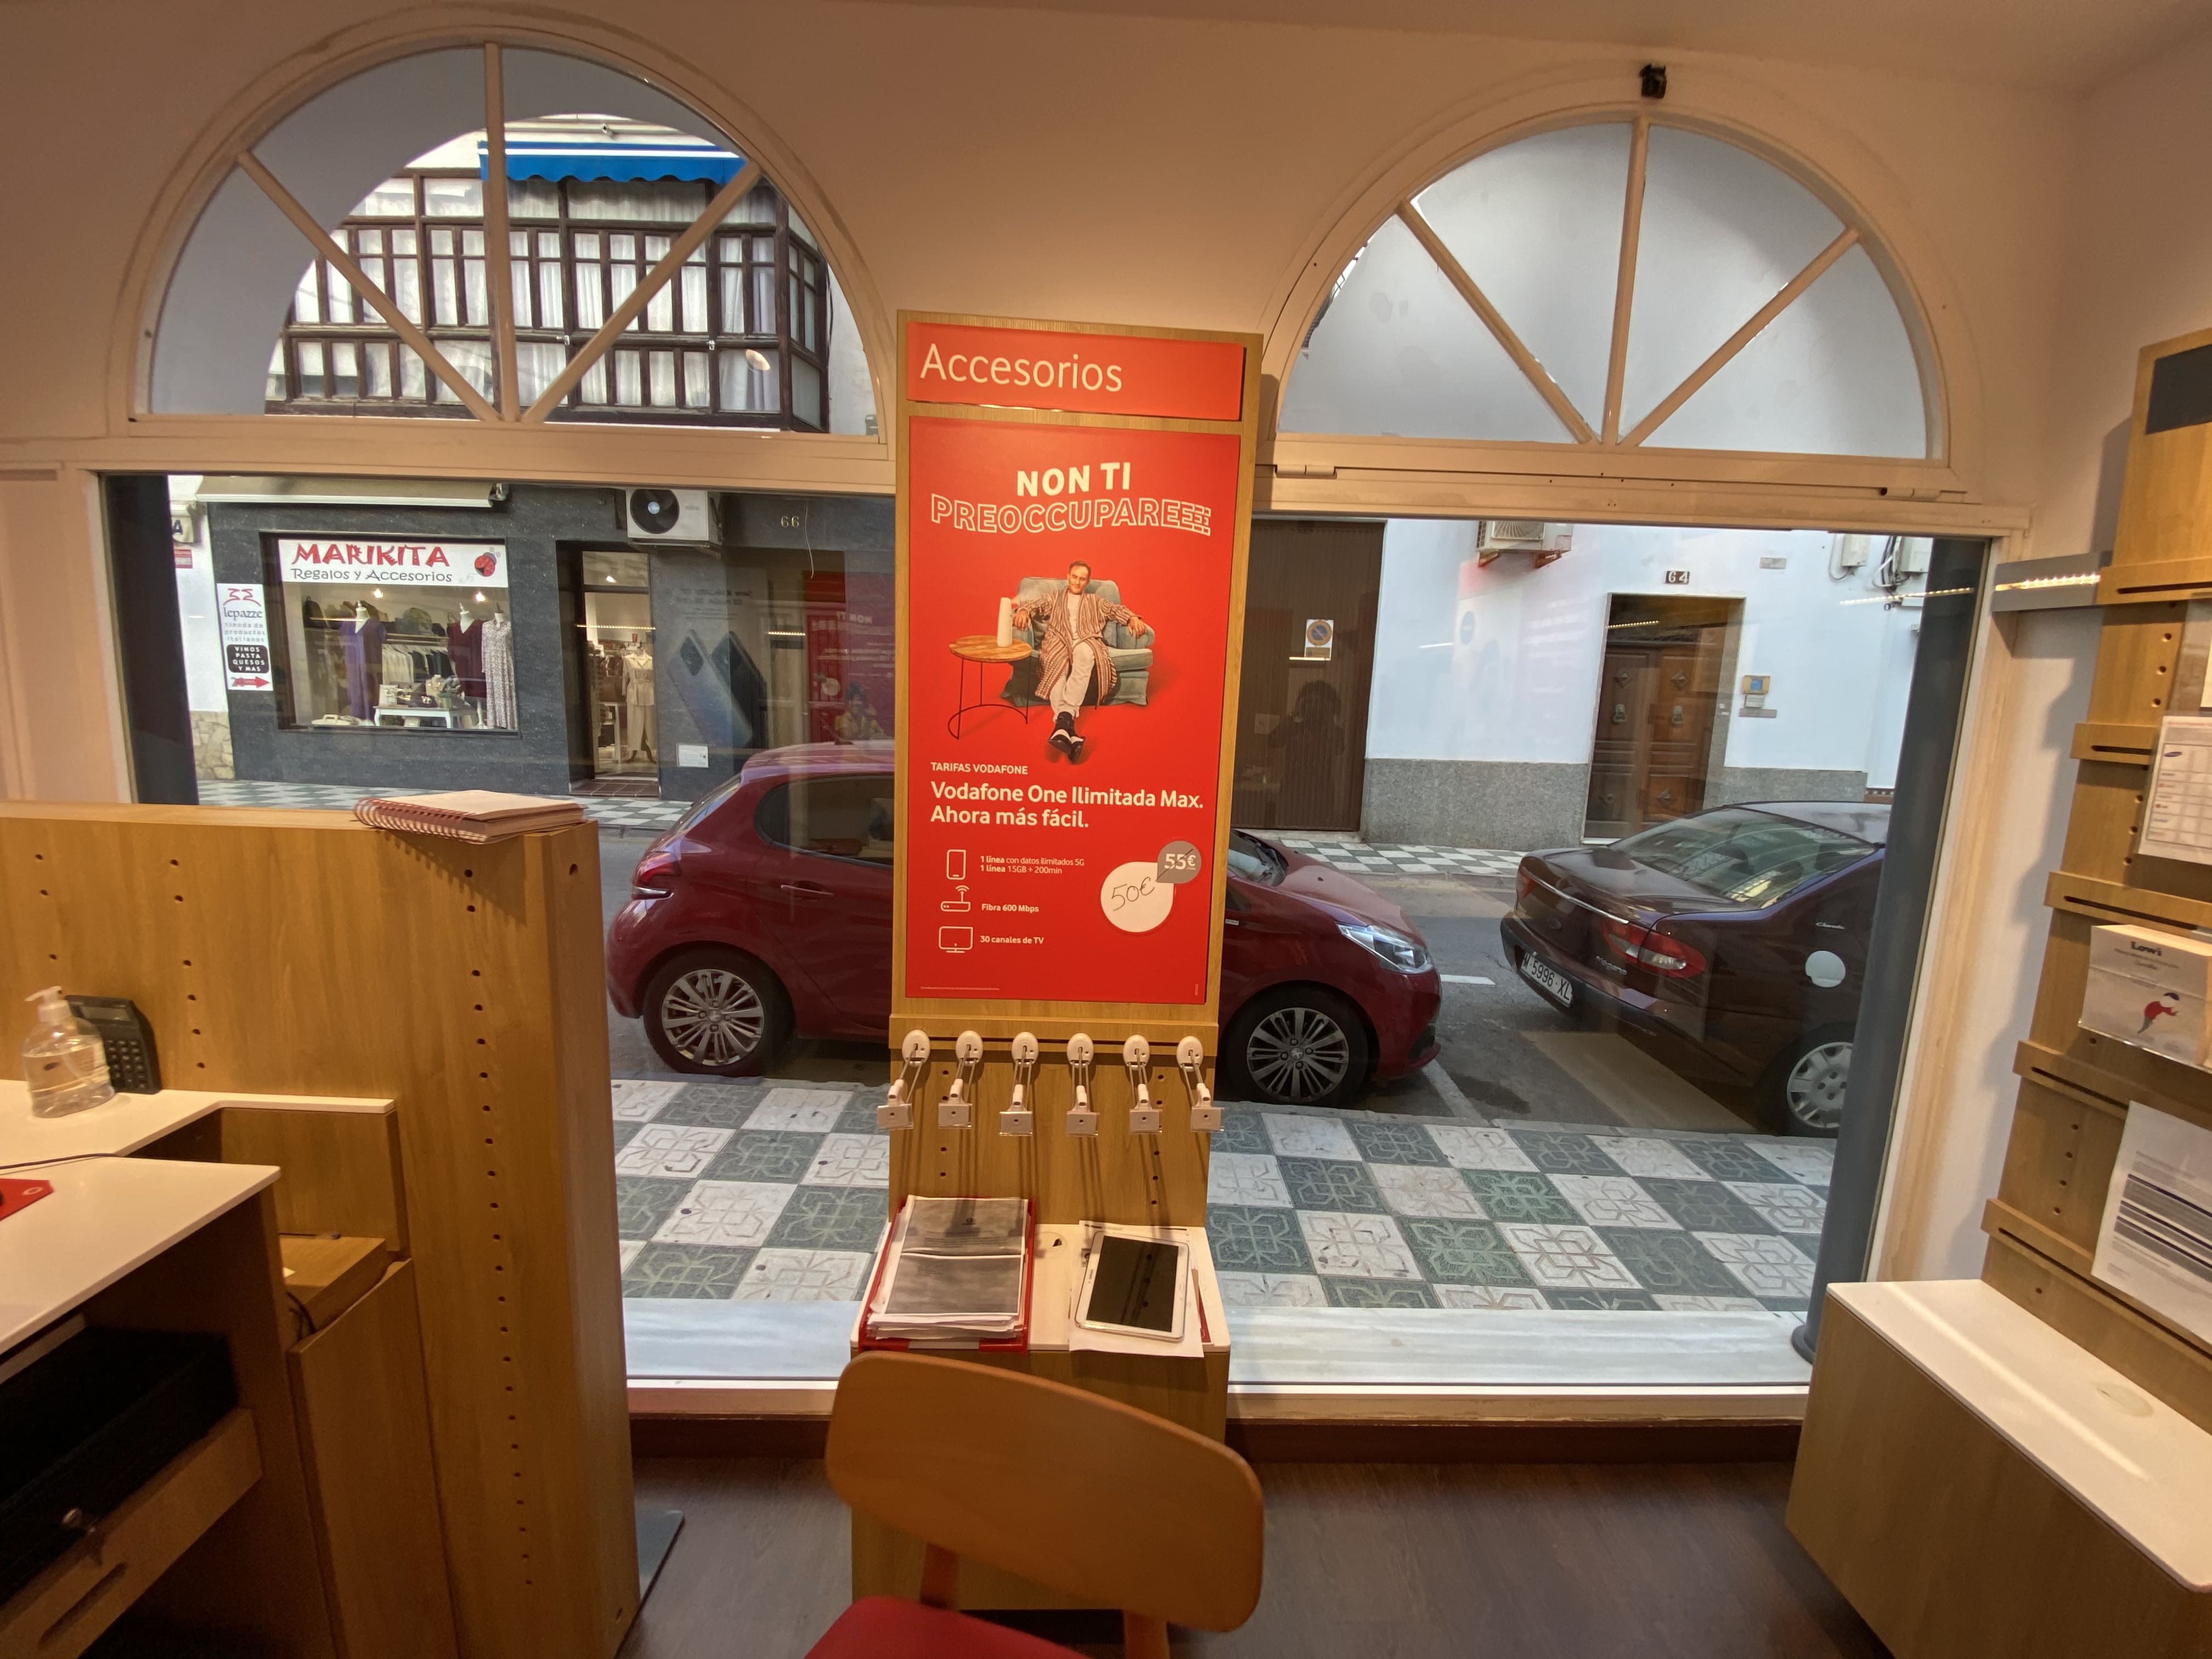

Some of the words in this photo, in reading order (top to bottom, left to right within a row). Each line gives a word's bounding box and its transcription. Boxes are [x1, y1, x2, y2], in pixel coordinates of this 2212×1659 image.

[919, 343, 1122, 392] Accesorios
[1017, 465, 1090, 496] NON
[1100, 461, 1131, 490] TI
[781, 516, 799, 528] 66
[292, 544, 450, 567] MARIKITA
[291, 568, 349, 580] Regalos
[355, 572, 362, 580] y
[365, 569, 453, 582] Accesorios
[1668, 571, 1688, 583] 64
[223, 607, 263, 620] lepazze
[930, 762, 971, 772] TARIFAS
[973, 764, 1028, 775] VODAFONE
[930, 781, 1024, 801] Vodafone
[1028, 785, 1067, 803] One
[1072, 786, 1155, 806] Ilimitada
[1160, 790, 1204, 809] Max.
[930, 805, 990, 824] Ahora
[996, 807, 1037, 826] más
[1042, 809, 1089, 828] fácil.
[1040, 857, 1074, 866] ilimitados
[1111, 877, 1155, 912] 50€
[1018, 905, 1039, 913] Mbps
